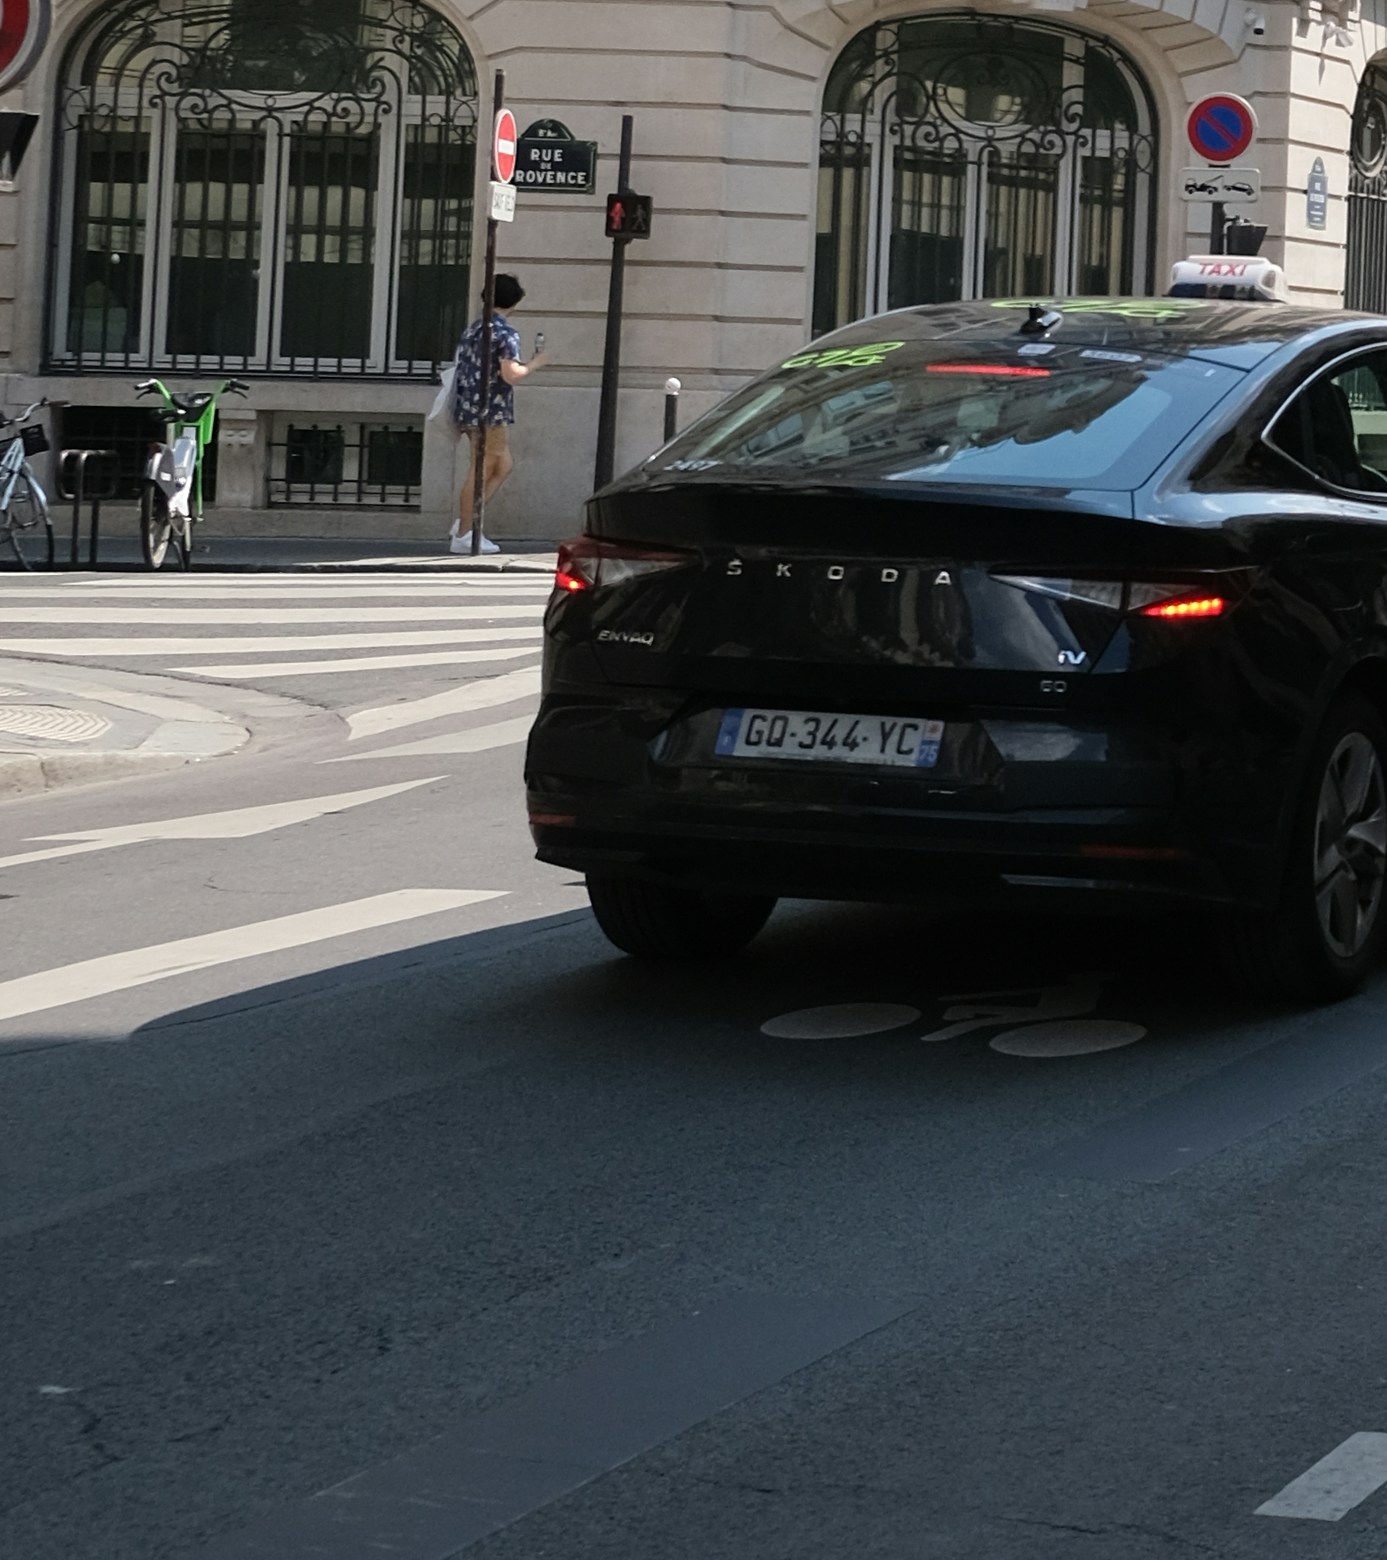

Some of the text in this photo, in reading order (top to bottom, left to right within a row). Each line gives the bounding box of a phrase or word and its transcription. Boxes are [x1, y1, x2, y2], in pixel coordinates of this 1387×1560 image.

[530, 149, 563, 161] RUE
[515, 170, 586, 184] ROVENCE
[1199, 263, 1249, 277] TAXI
[744, 713, 919, 756] GQ-344-YC
[918, 743, 939, 762] 75
